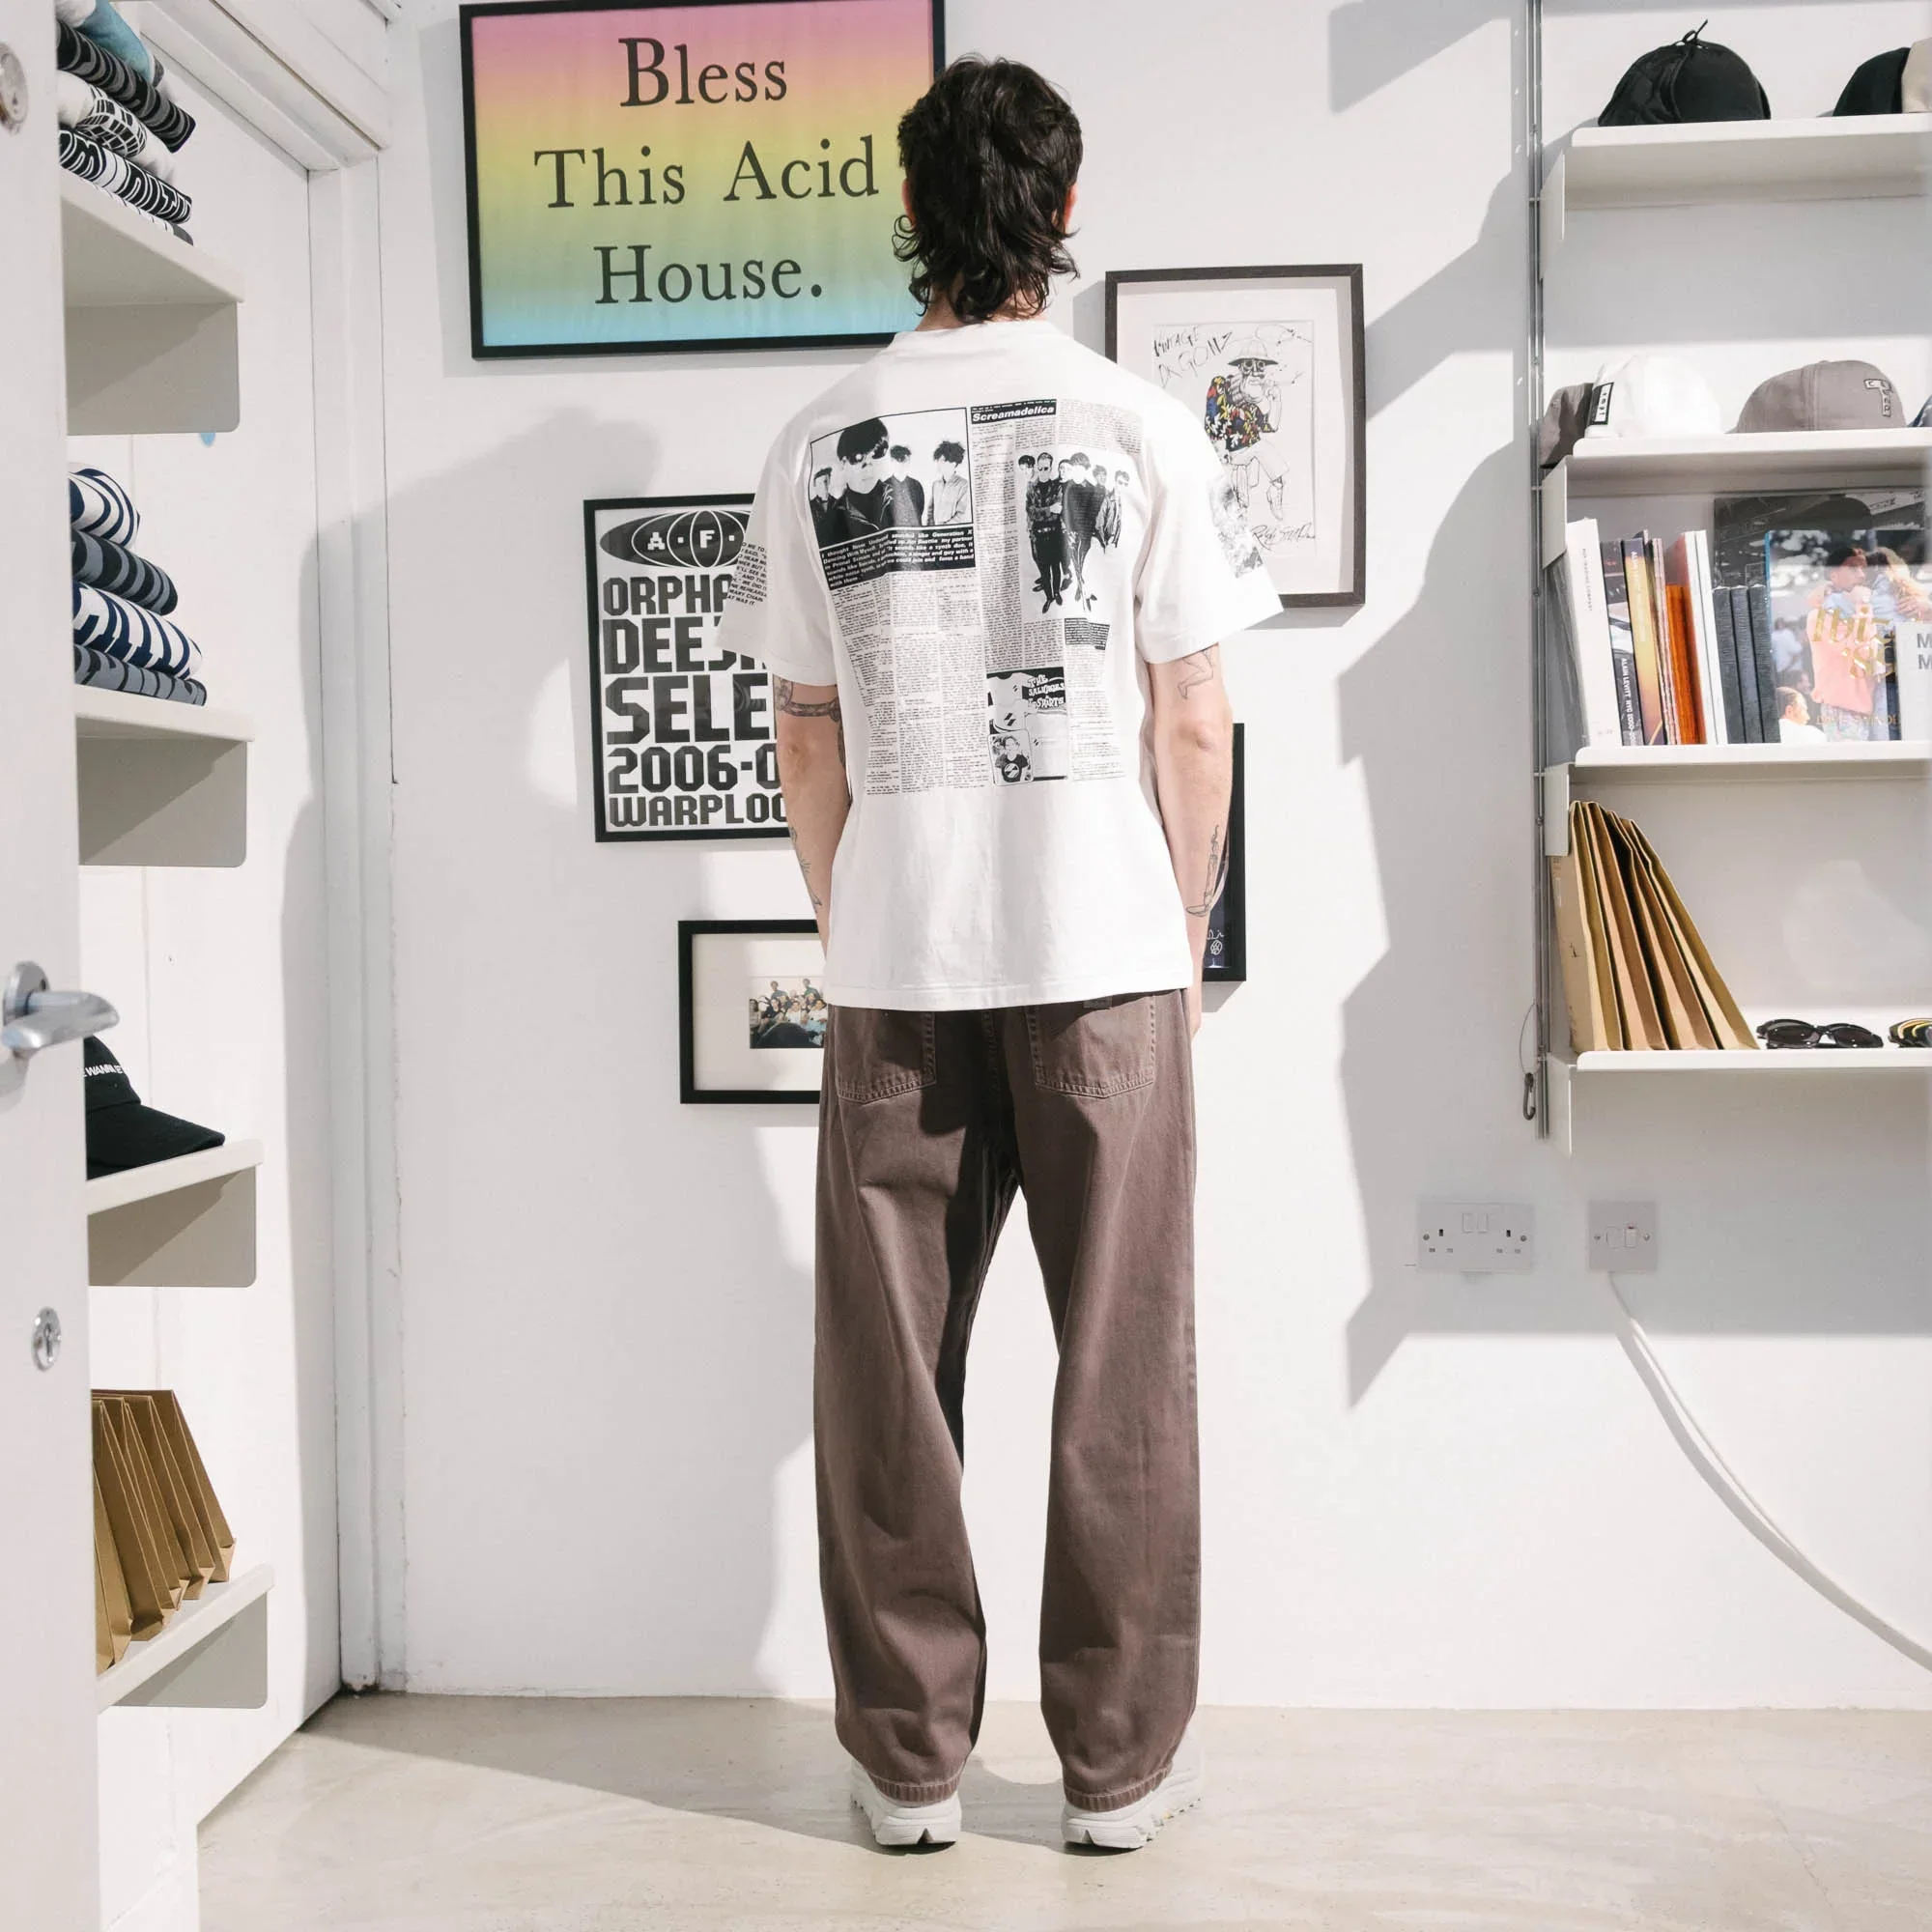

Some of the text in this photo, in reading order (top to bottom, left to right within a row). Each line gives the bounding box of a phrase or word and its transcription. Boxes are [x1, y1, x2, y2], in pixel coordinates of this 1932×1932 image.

[618, 38, 787, 107] Bless
[534, 135, 879, 209] This Acid
[594, 244, 822, 304] House.
[972, 406, 1054, 422] Screamadelica
